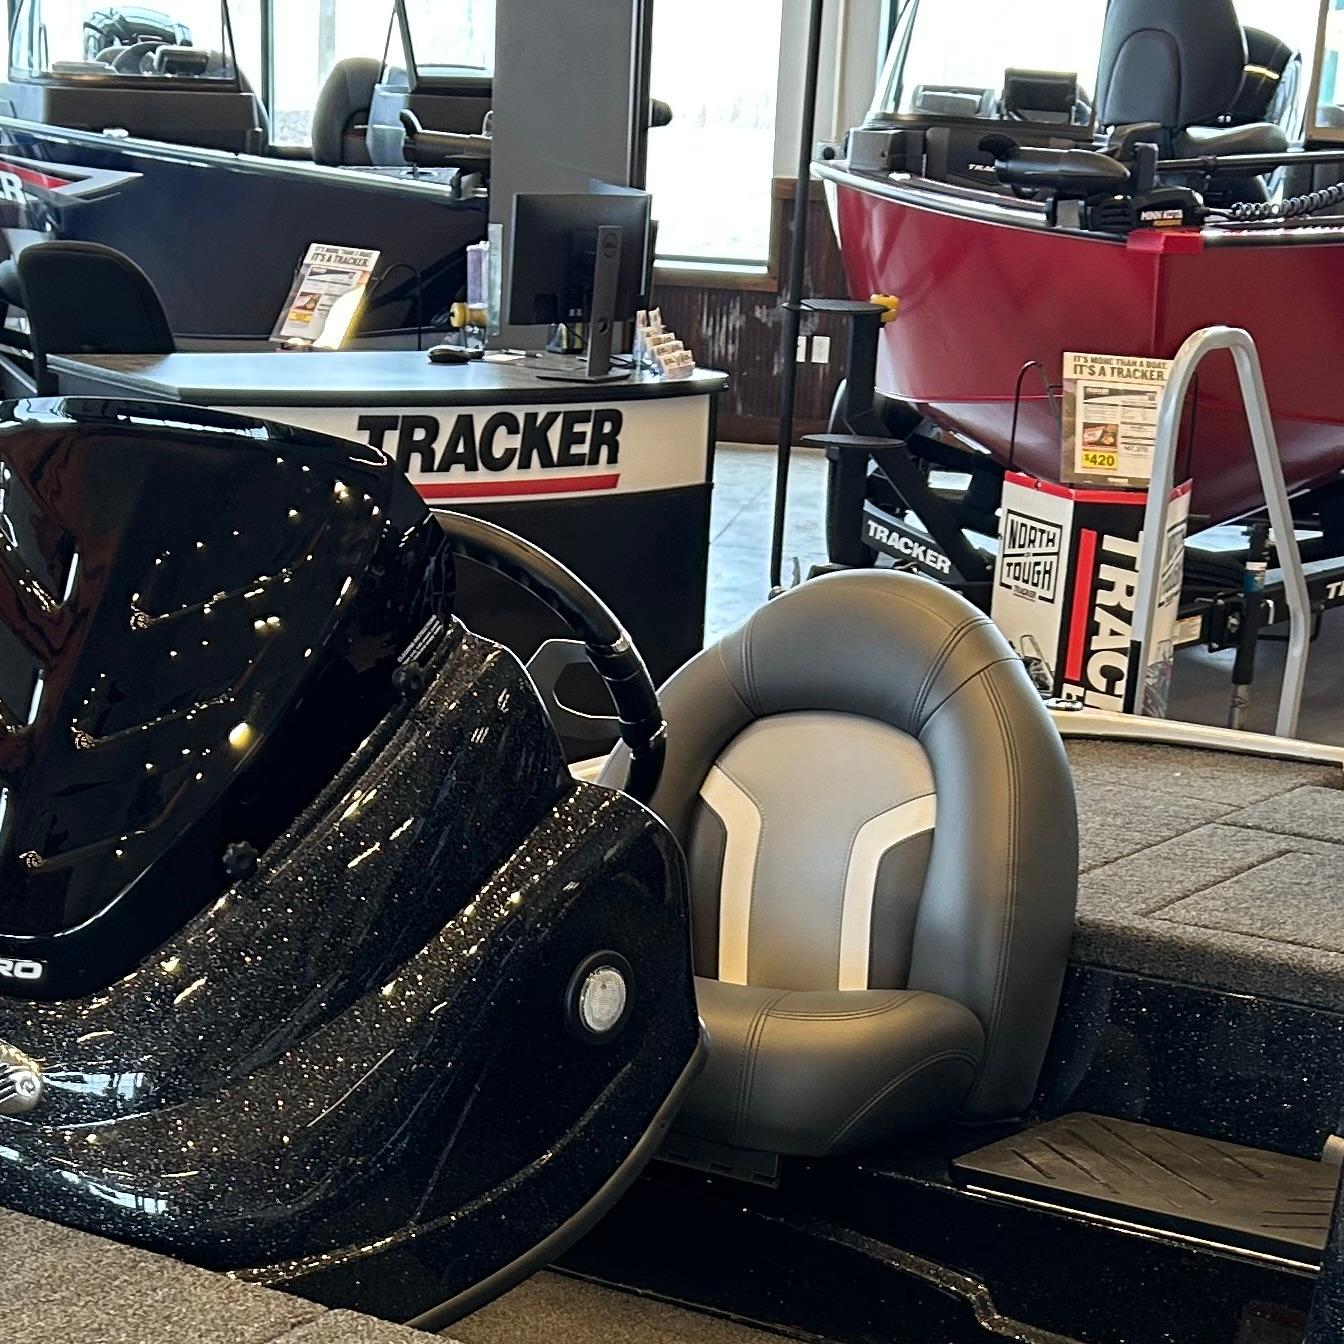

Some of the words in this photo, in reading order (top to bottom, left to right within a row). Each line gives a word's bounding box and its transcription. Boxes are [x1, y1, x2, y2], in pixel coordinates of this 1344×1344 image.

[1073, 364, 1096, 376] IT'S
[1098, 365, 1107, 377] A
[357, 408, 623, 473] TRACKER
[1084, 454, 1115, 467] $420
[867, 520, 951, 574] TRACKER
[1008, 518, 1056, 549] NORTH
[1005, 559, 1054, 592] TOUGH
[1085, 531, 1144, 713] TRAC
